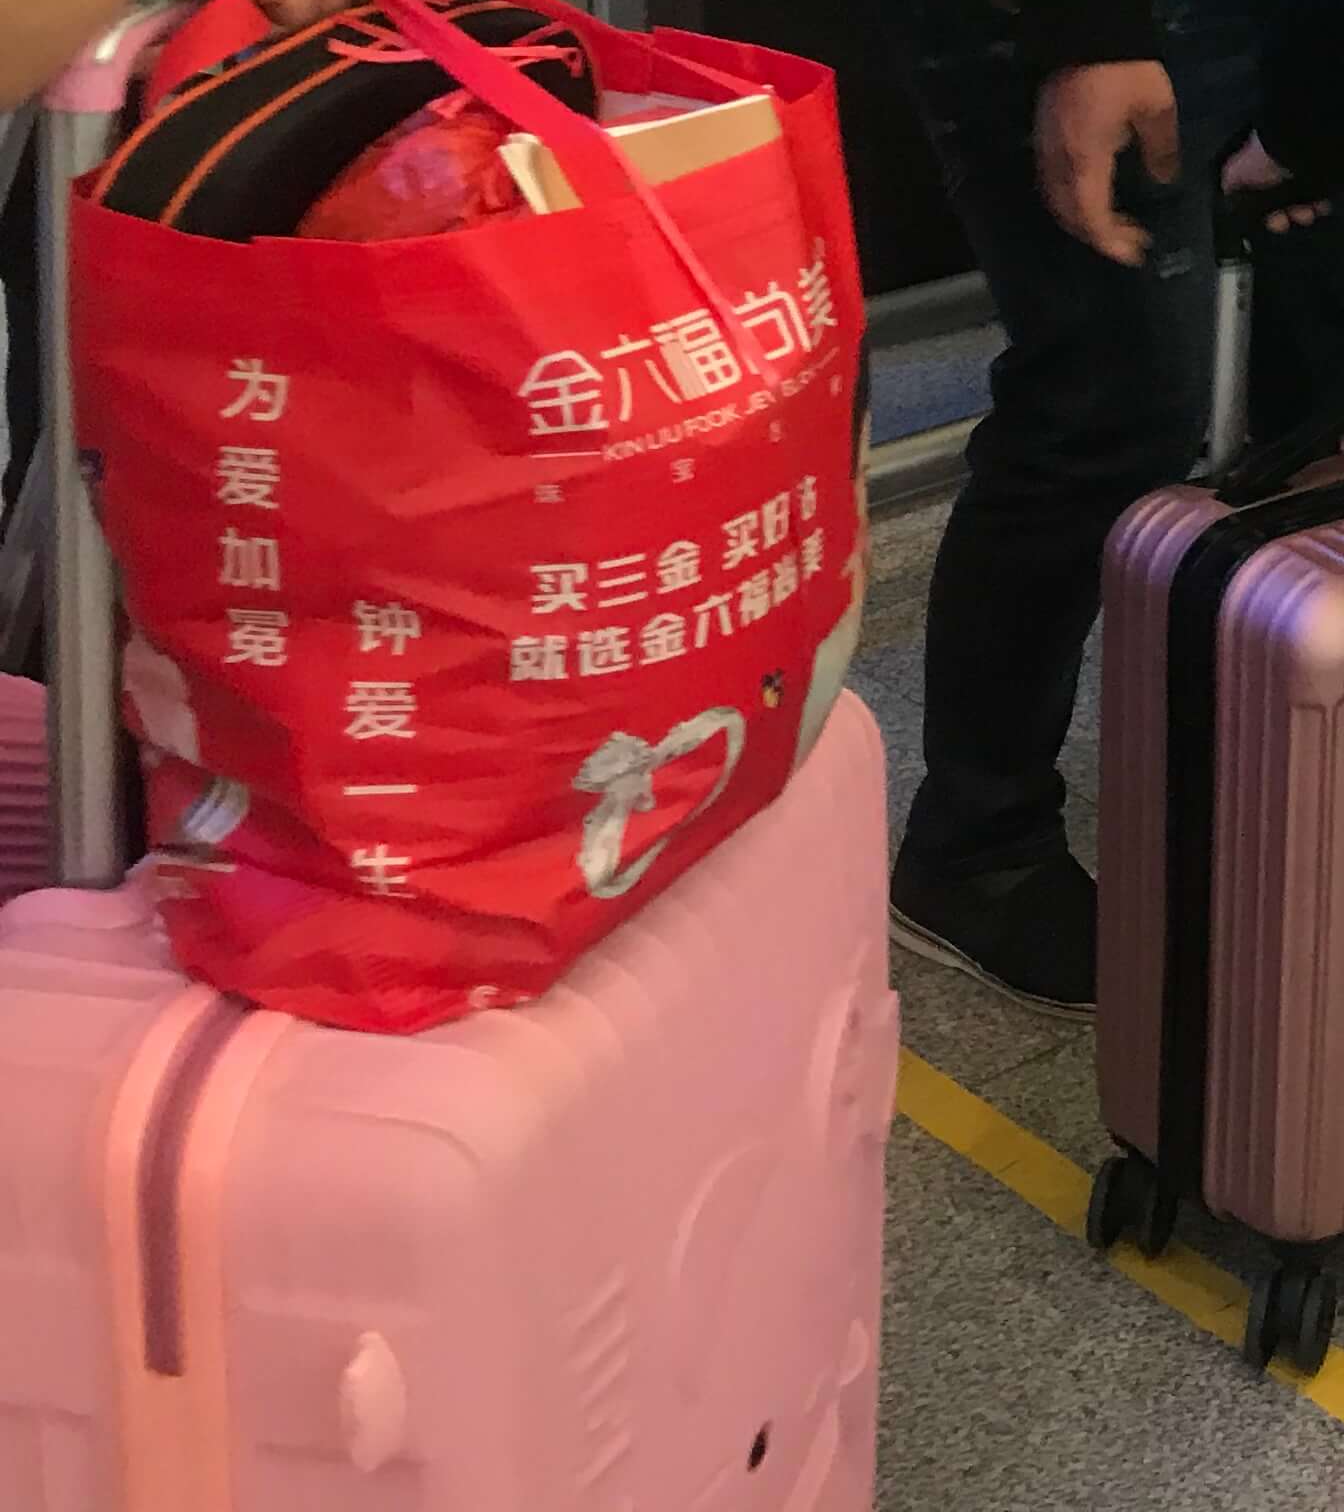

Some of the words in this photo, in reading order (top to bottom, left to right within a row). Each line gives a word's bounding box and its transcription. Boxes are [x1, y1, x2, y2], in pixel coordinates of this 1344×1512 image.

[215, 357, 290, 667] 为爱加冕
[529, 539, 702, 615] 买三金
[343, 598, 423, 900] 钟爱一生
